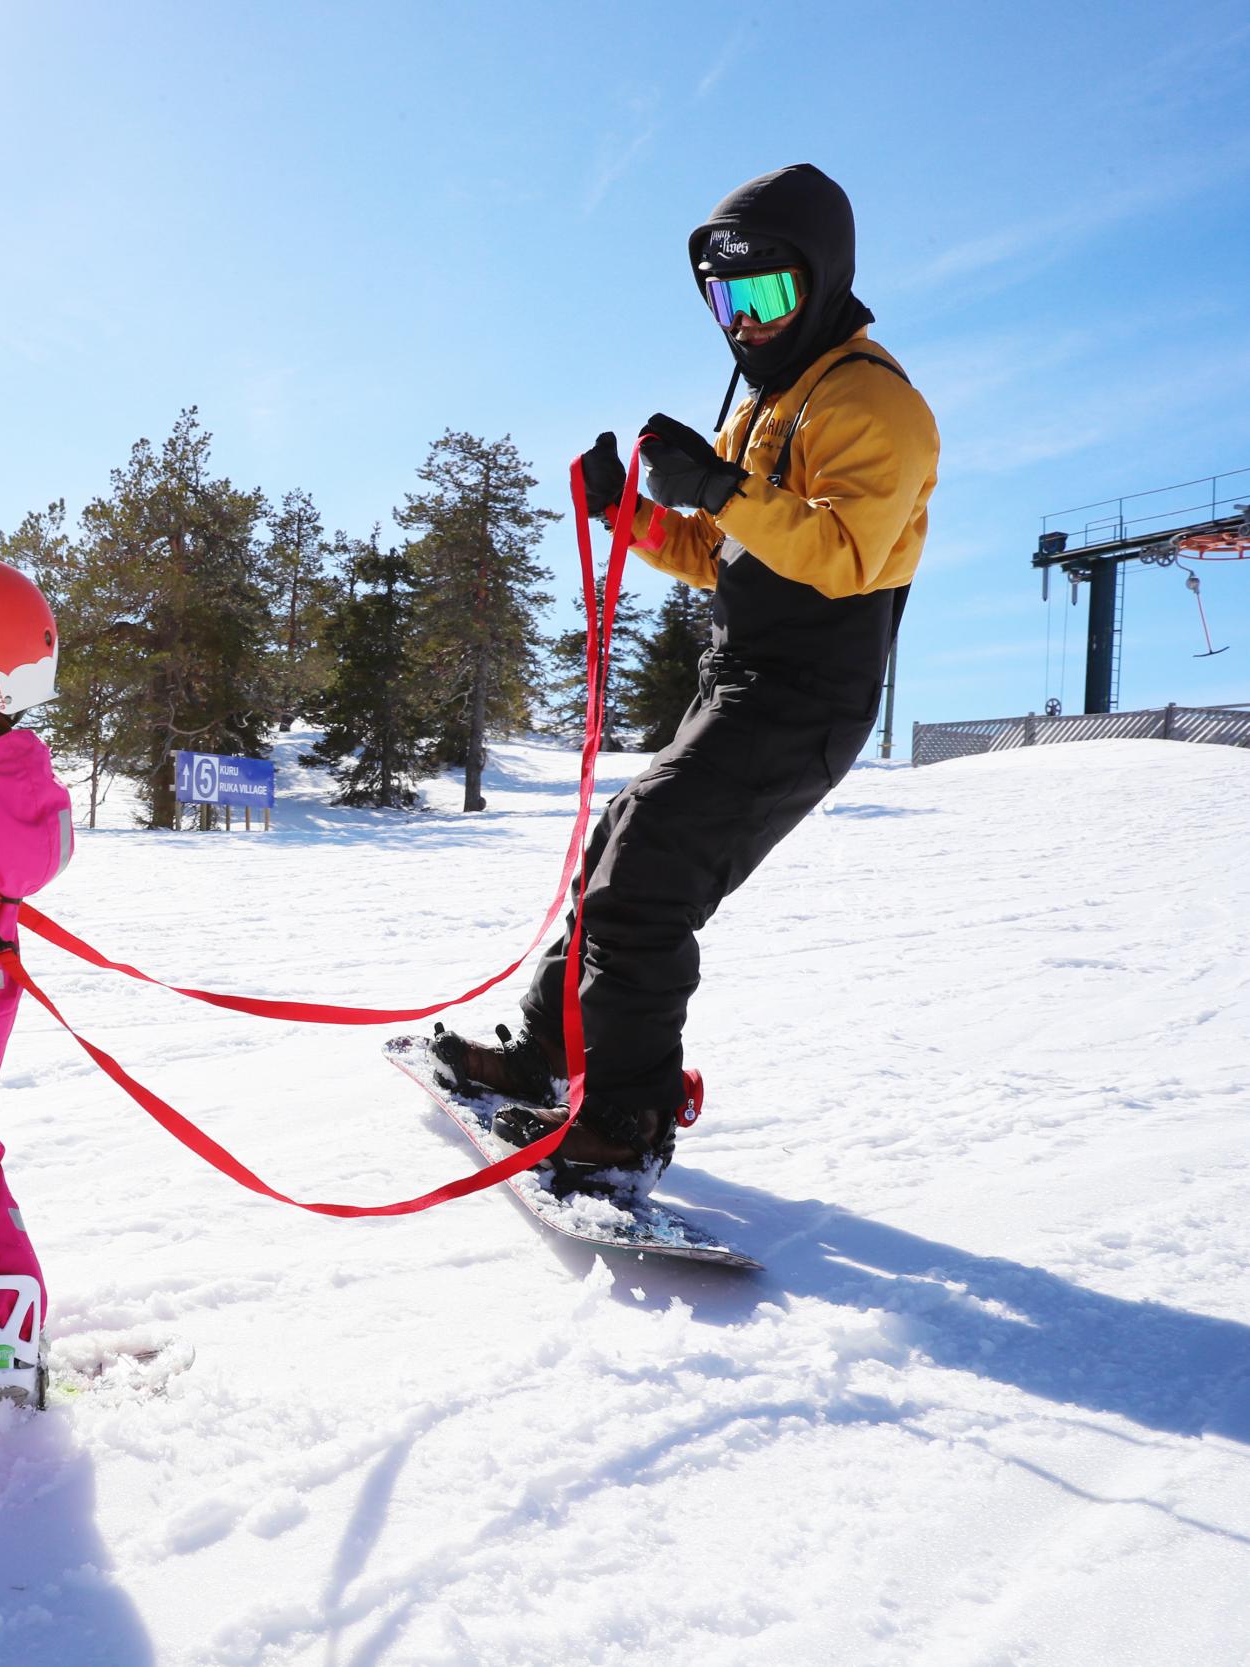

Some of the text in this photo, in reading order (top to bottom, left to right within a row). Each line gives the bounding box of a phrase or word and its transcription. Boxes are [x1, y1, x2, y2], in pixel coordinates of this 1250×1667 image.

[220, 765, 238, 776] KURU
[200, 763, 212, 794] 5
[219, 782, 267, 795] RUKA VILLAGE
